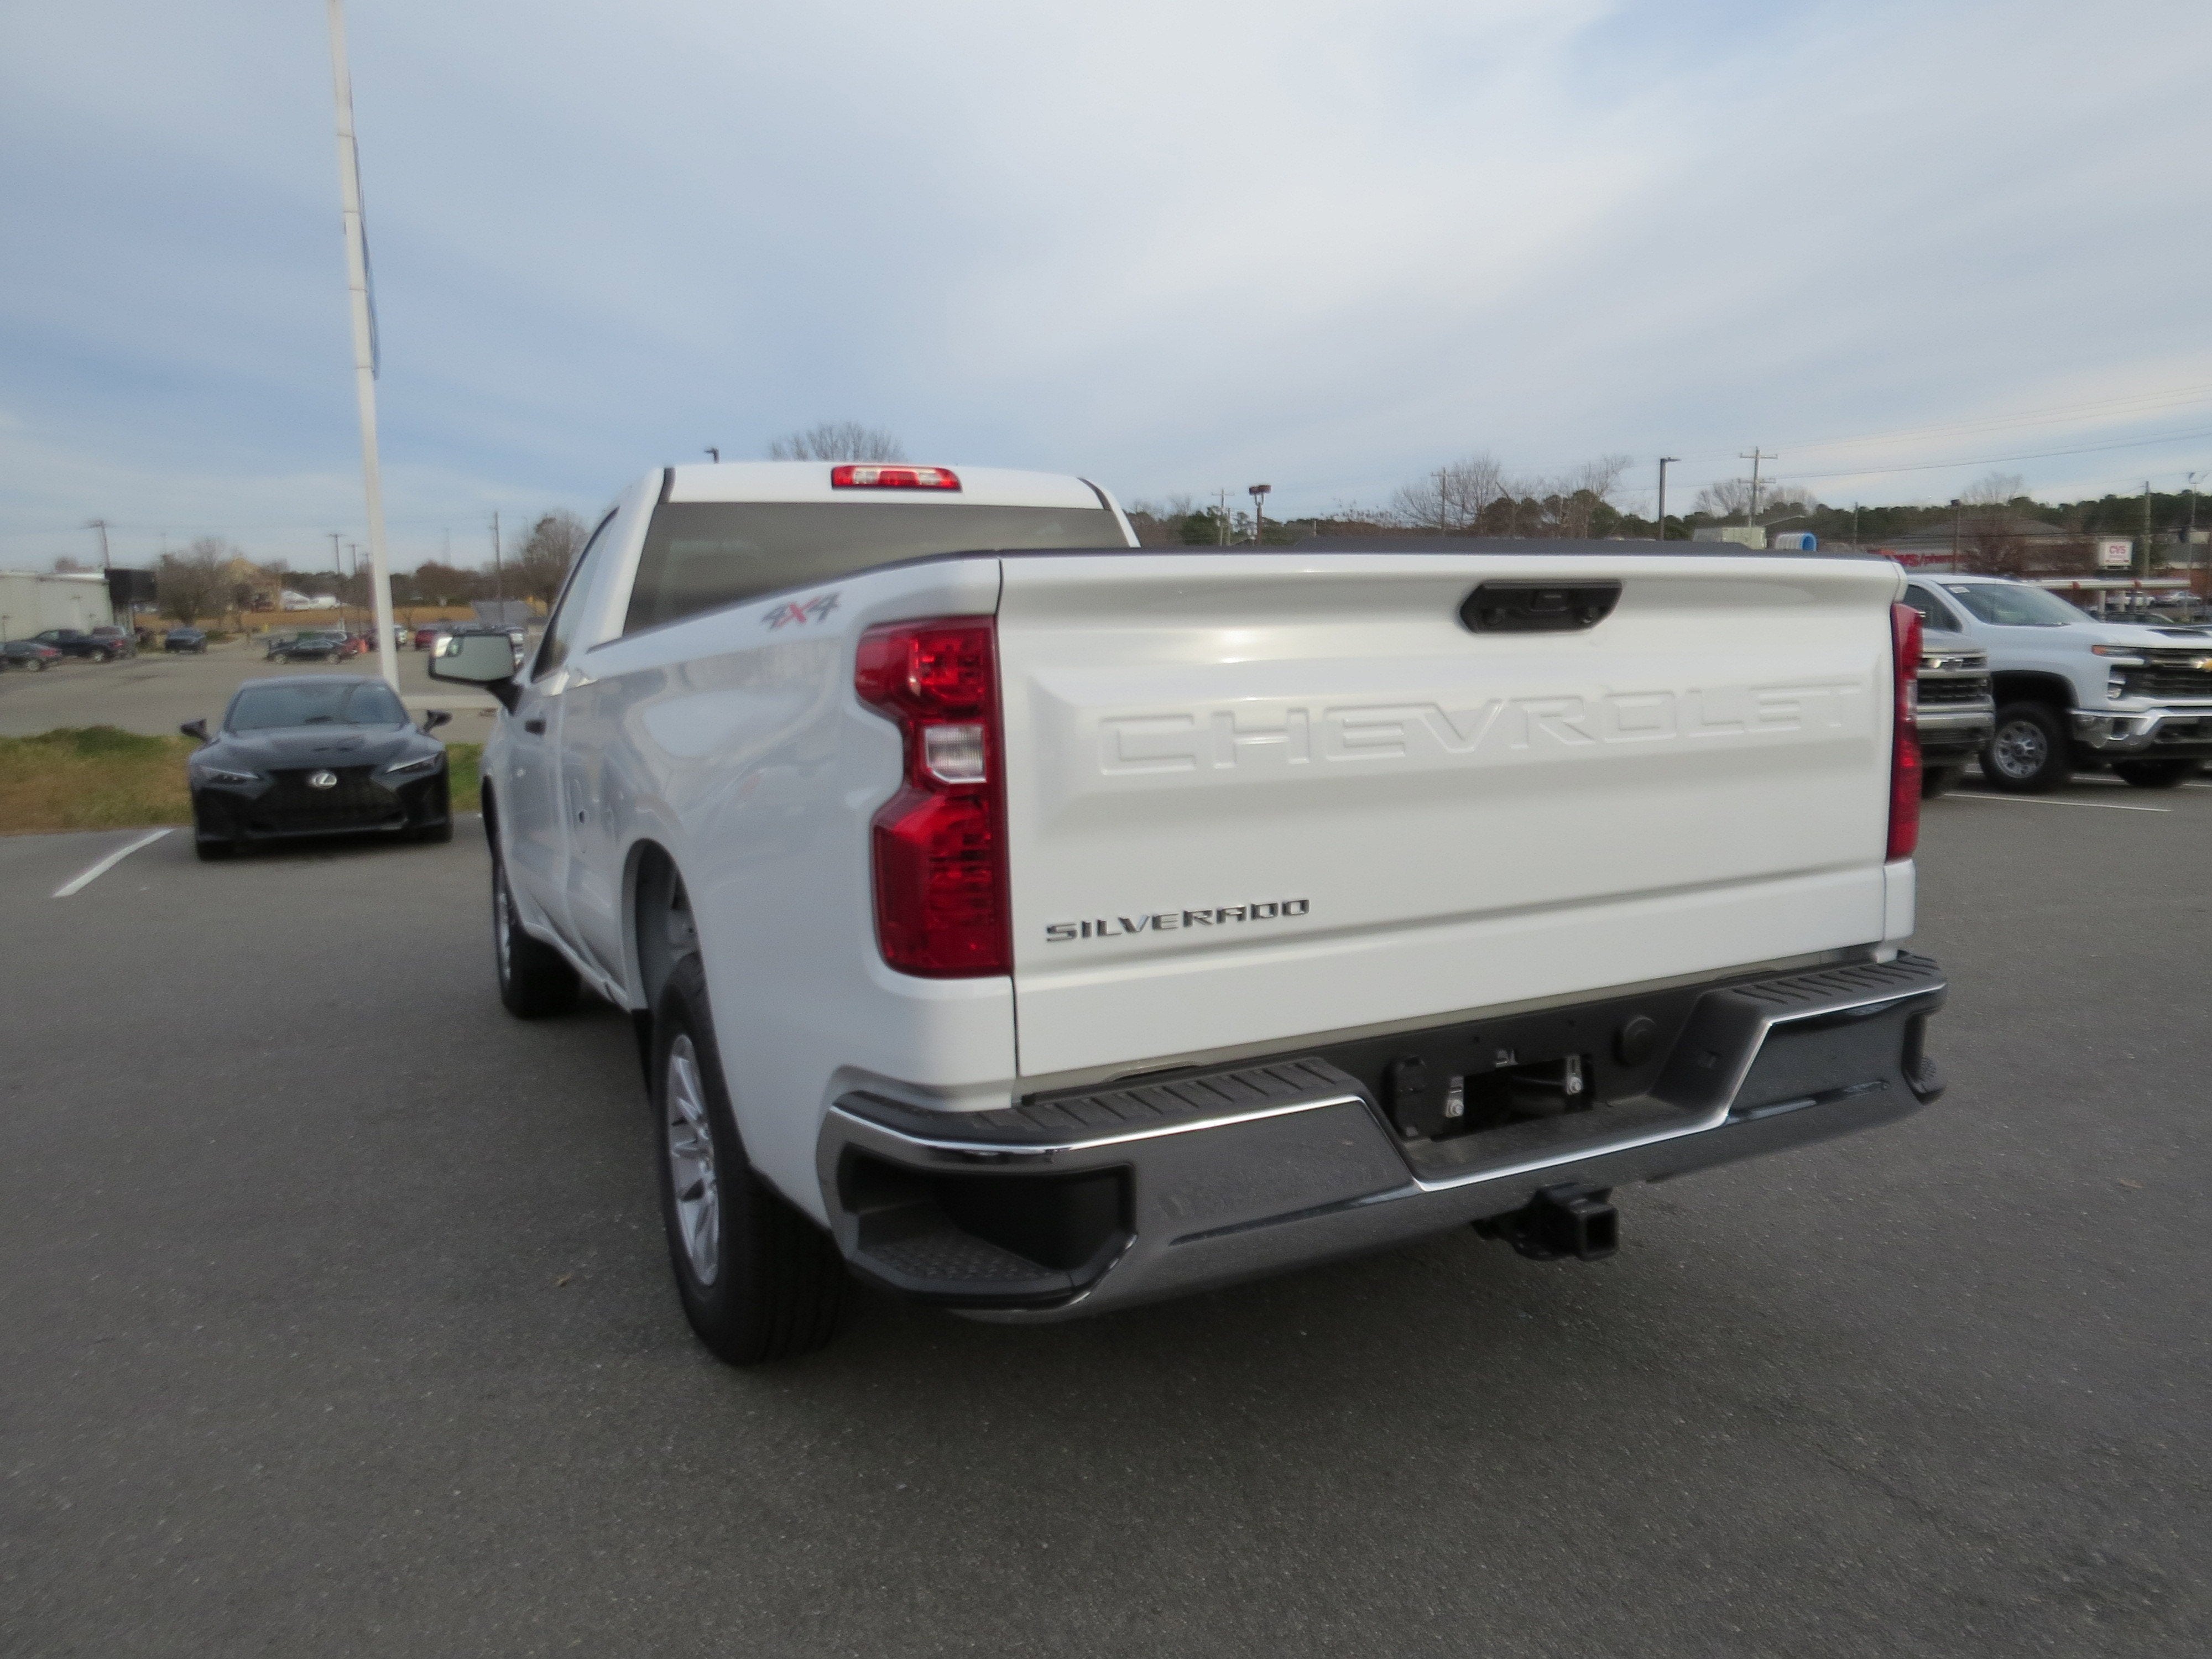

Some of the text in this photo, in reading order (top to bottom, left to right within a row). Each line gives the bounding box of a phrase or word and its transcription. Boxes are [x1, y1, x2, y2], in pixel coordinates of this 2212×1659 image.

[2109, 545, 2126, 554] CVS
[1098, 682, 1861, 774] CHEVROLET
[1046, 899, 1310, 942] SILVERADO
